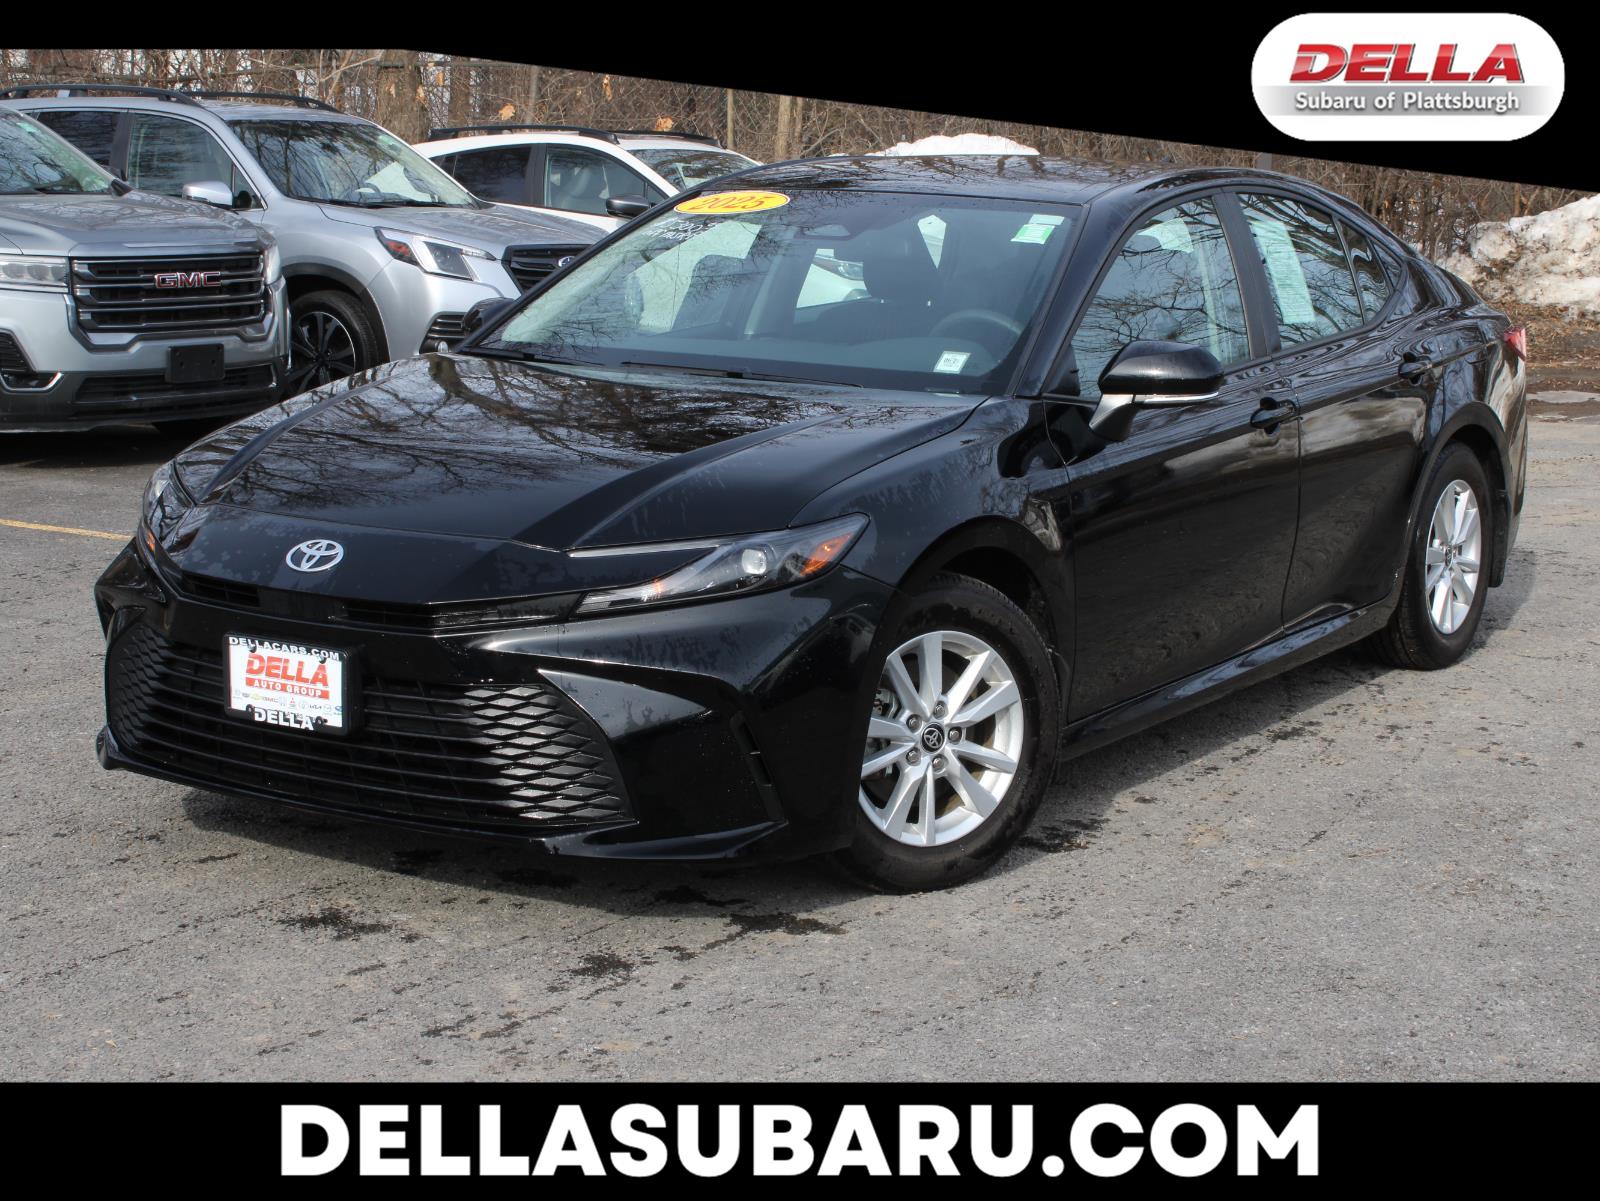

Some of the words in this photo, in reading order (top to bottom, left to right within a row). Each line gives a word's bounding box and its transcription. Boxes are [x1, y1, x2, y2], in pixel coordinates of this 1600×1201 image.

[688, 196, 773, 210] 2025
[154, 271, 221, 288] GMC
[228, 636, 340, 661] DELLACARS.COM
[245, 653, 329, 687] DELLA
[253, 679, 282, 690] AUTO
[286, 684, 322, 697] GROUP
[254, 707, 315, 731] DELLA
